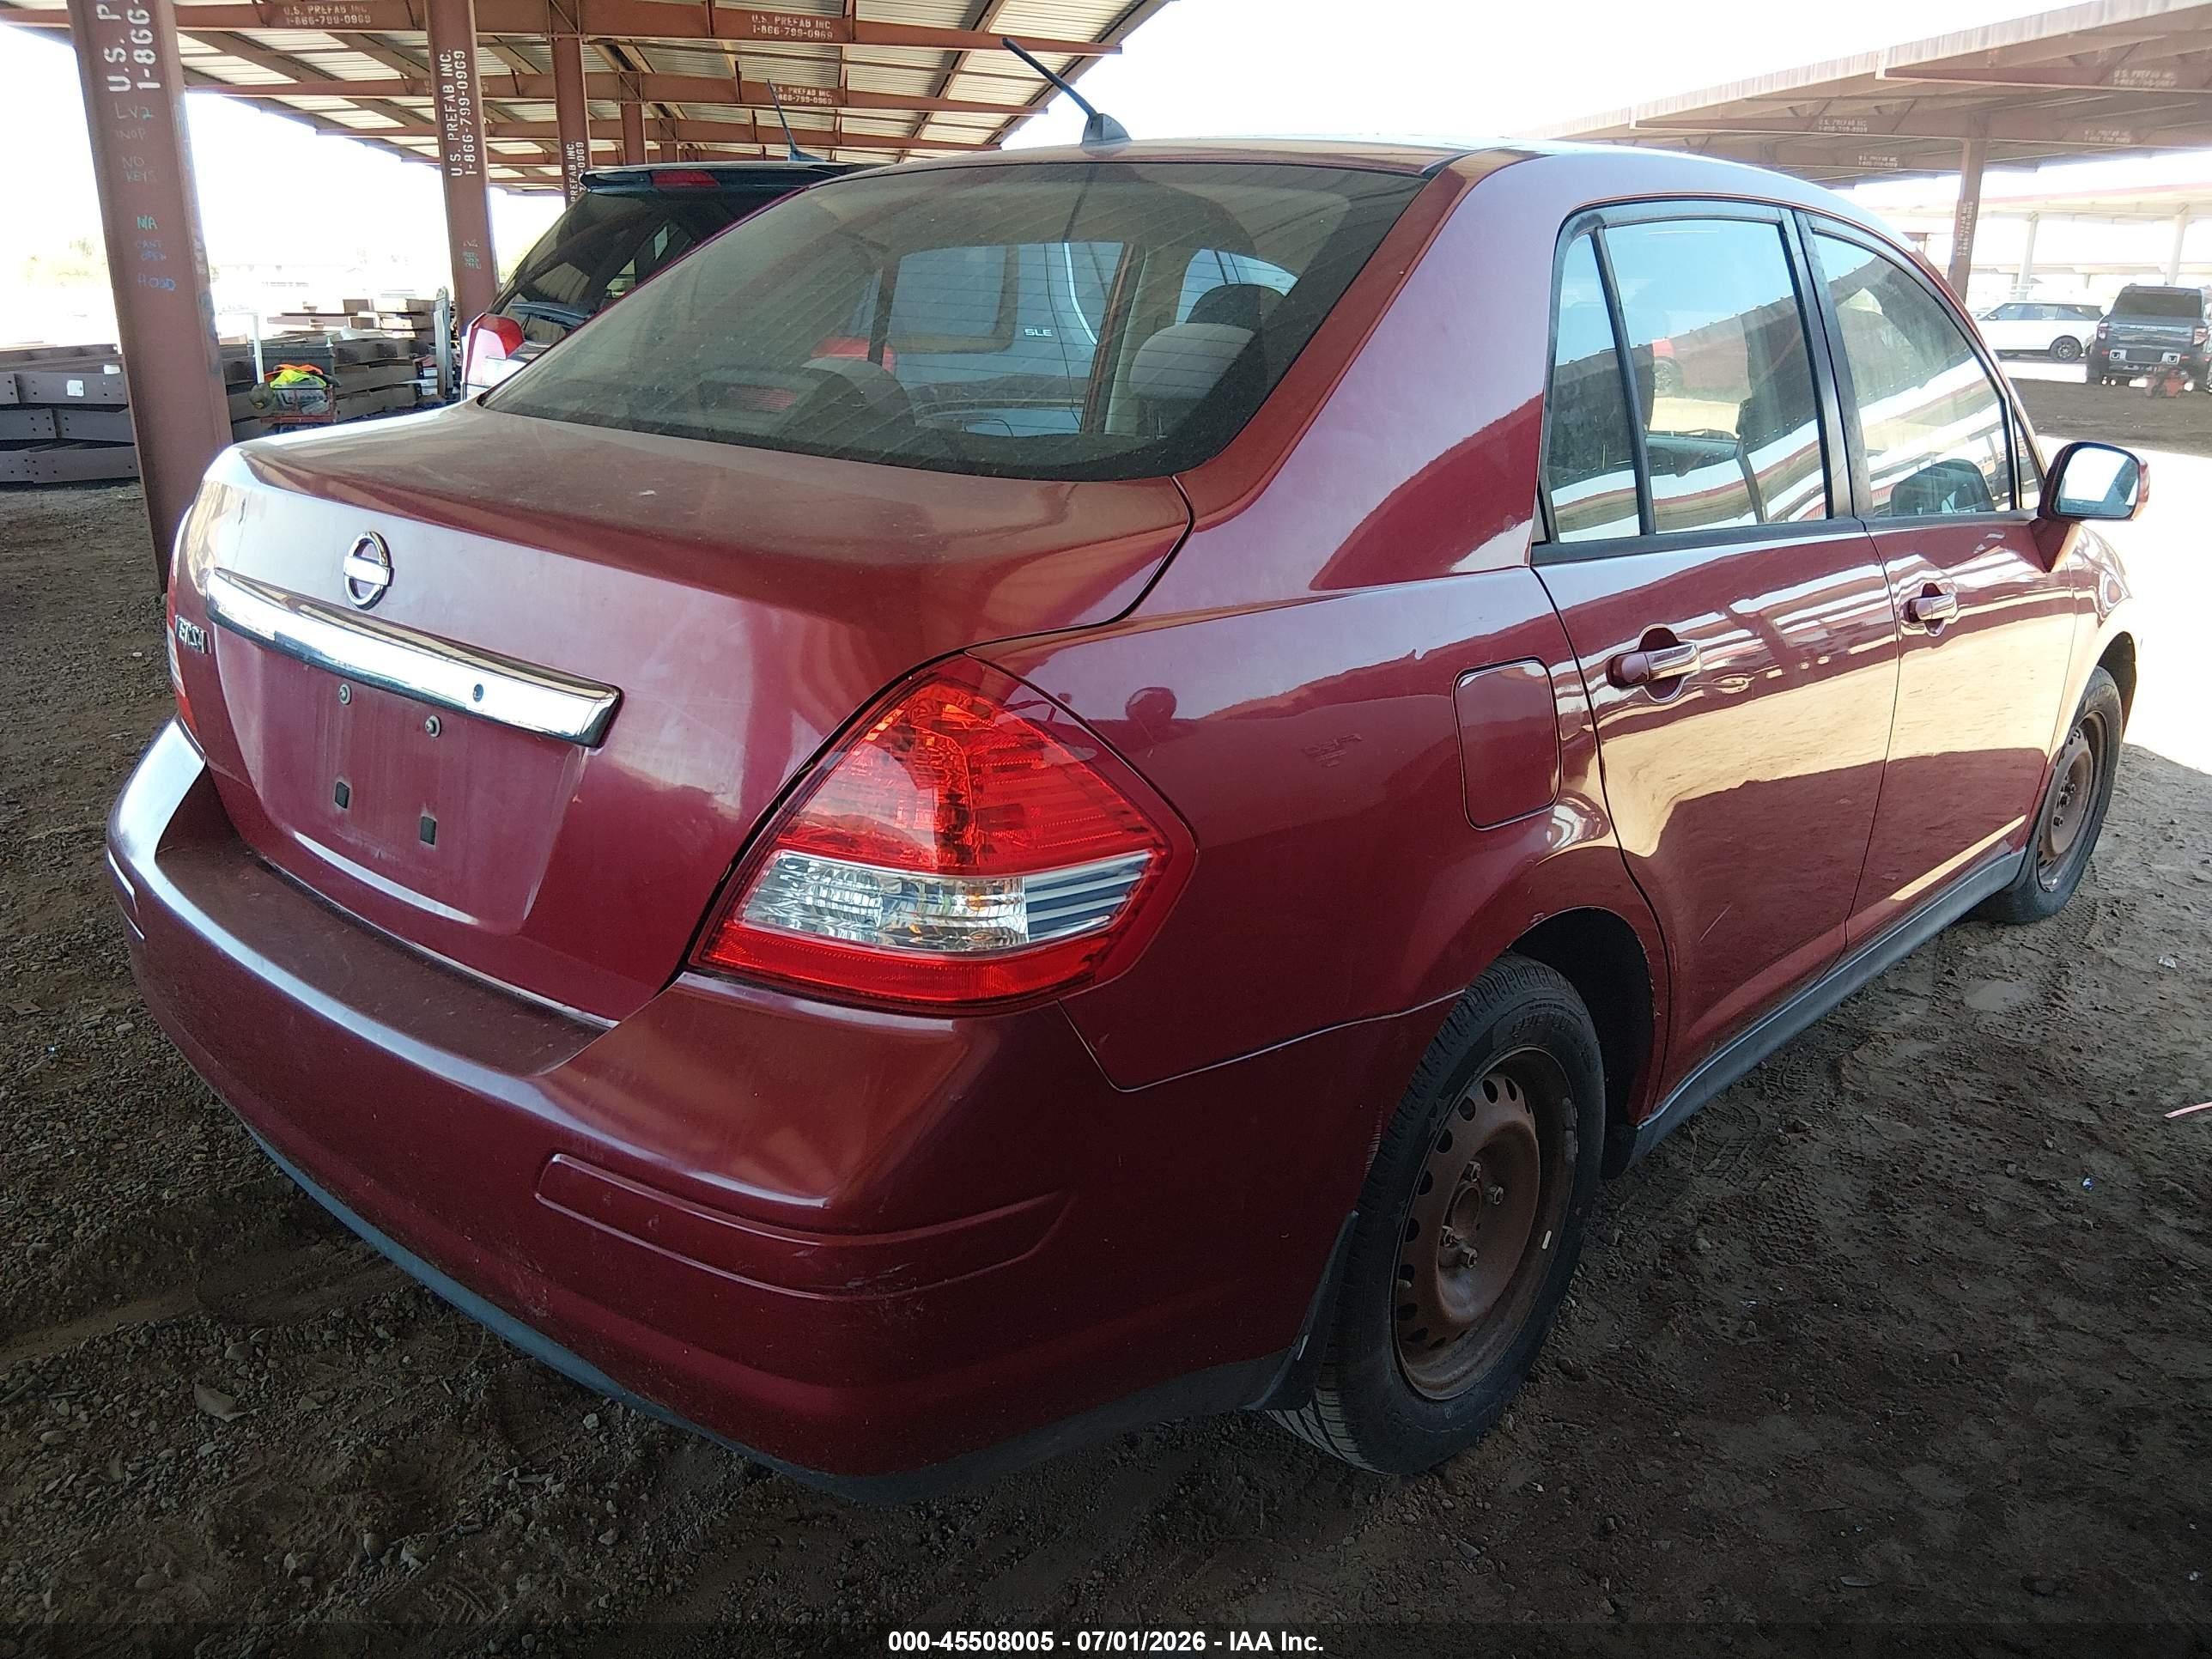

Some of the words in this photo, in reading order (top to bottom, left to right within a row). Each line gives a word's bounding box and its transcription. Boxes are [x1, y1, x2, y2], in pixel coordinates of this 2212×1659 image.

[307, 4, 347, 15] PREFAB
[752, 24, 834, 40] 1-866-799-0969
[104, 39, 131, 92] U.S.
[440, 49, 453, 76] INC.
[442, 85, 459, 141] PREFAB
[453, 50, 477, 175] 1-866-799-0969
[450, 149, 463, 176] U.S.
[1024, 328, 1053, 337] SLE
